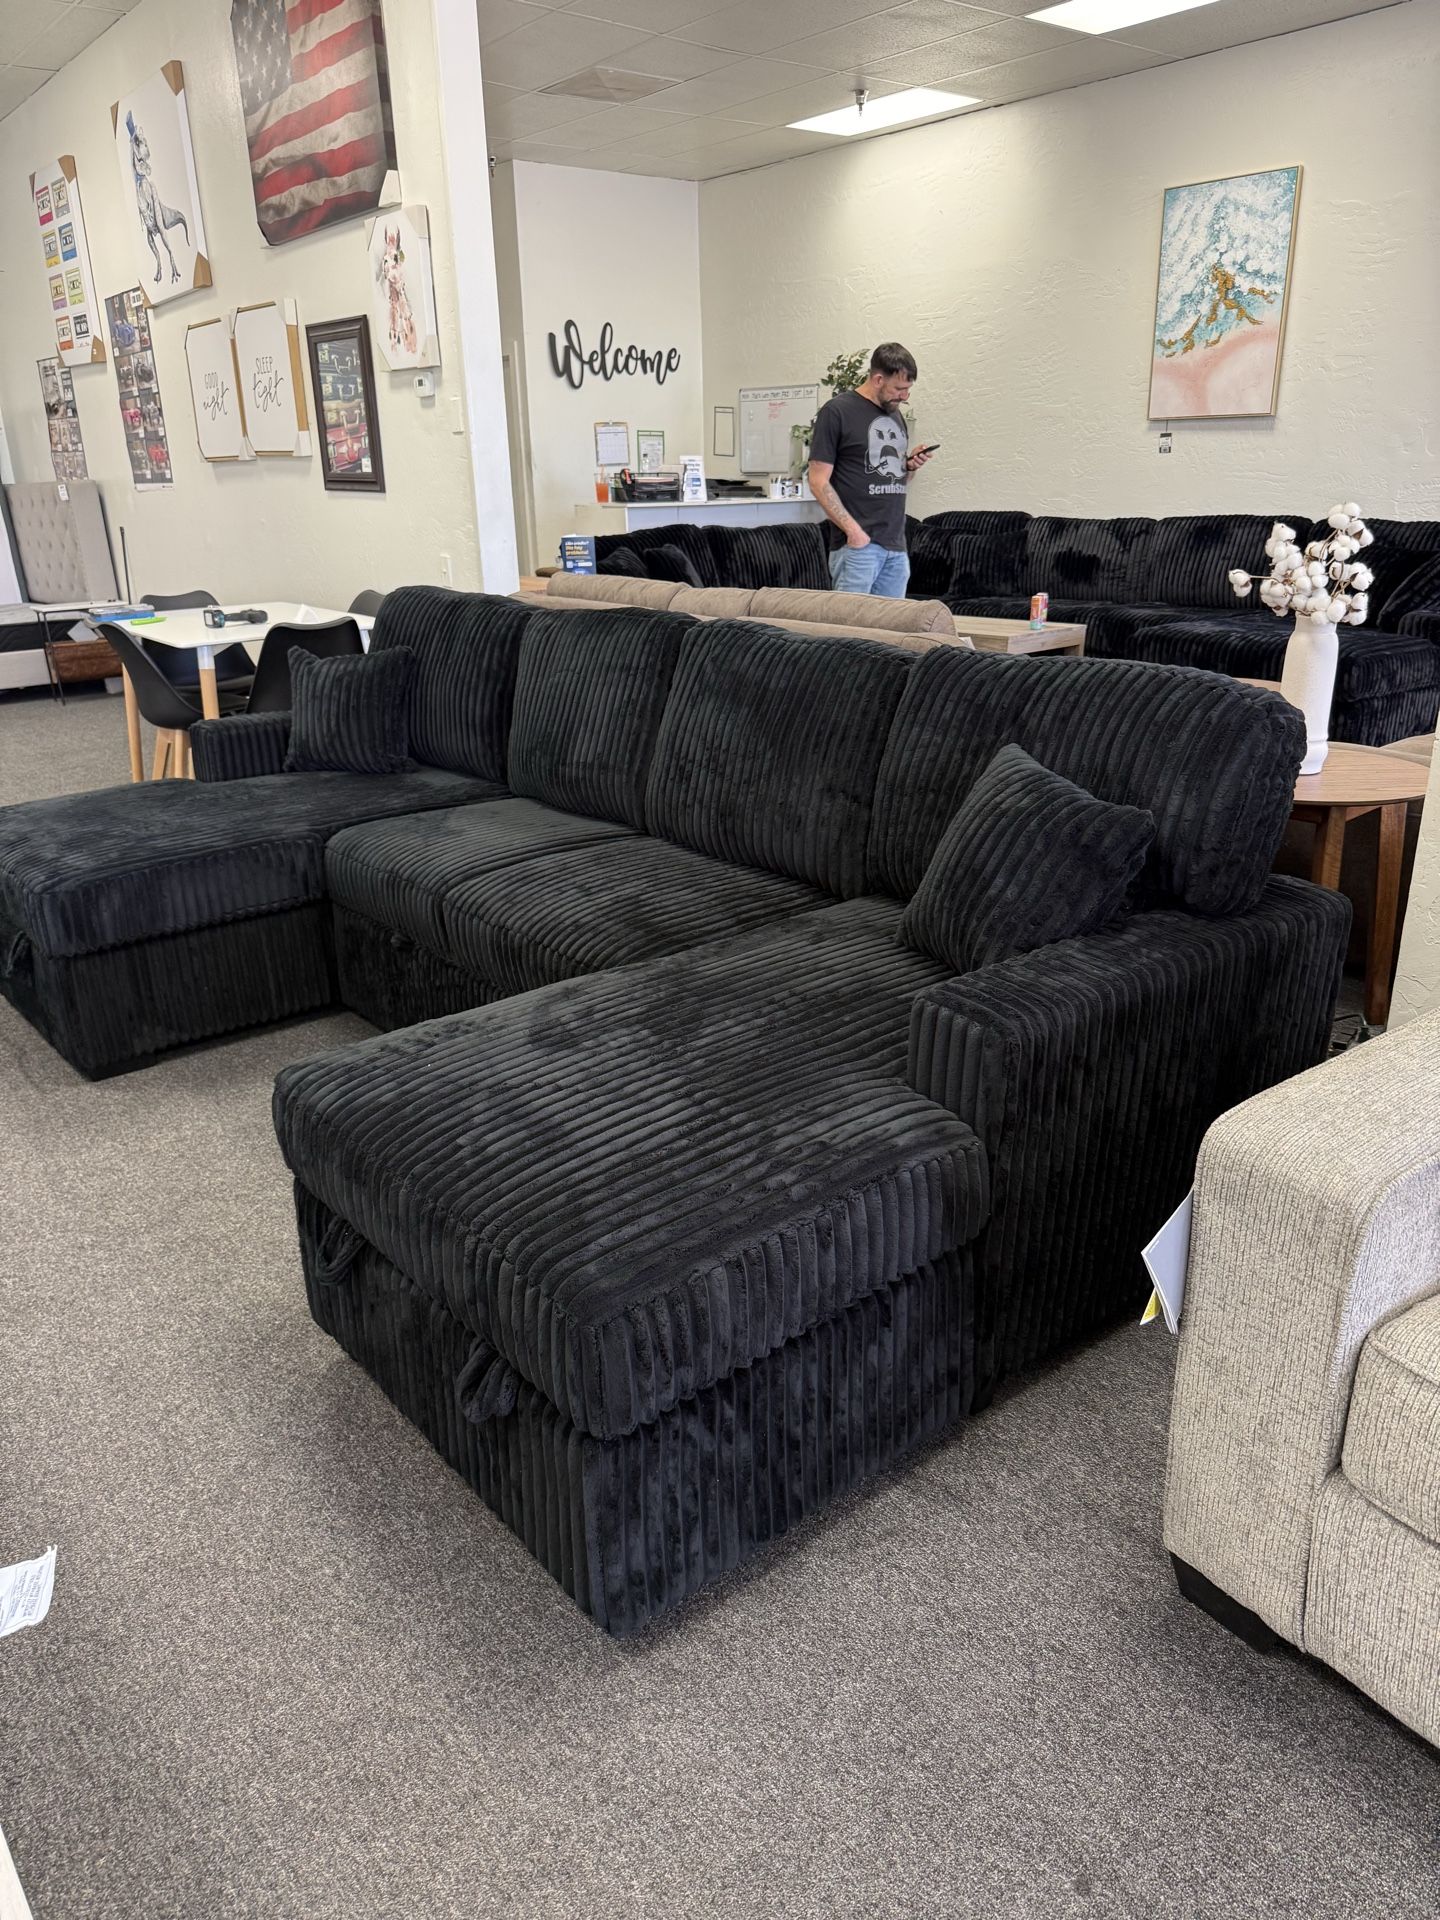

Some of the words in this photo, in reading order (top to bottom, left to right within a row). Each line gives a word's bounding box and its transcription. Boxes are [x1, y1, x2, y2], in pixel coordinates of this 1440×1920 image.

[255, 355, 273, 375] SLEEP
[547, 319, 681, 389] Welcome
[252, 369, 285, 412] tight
